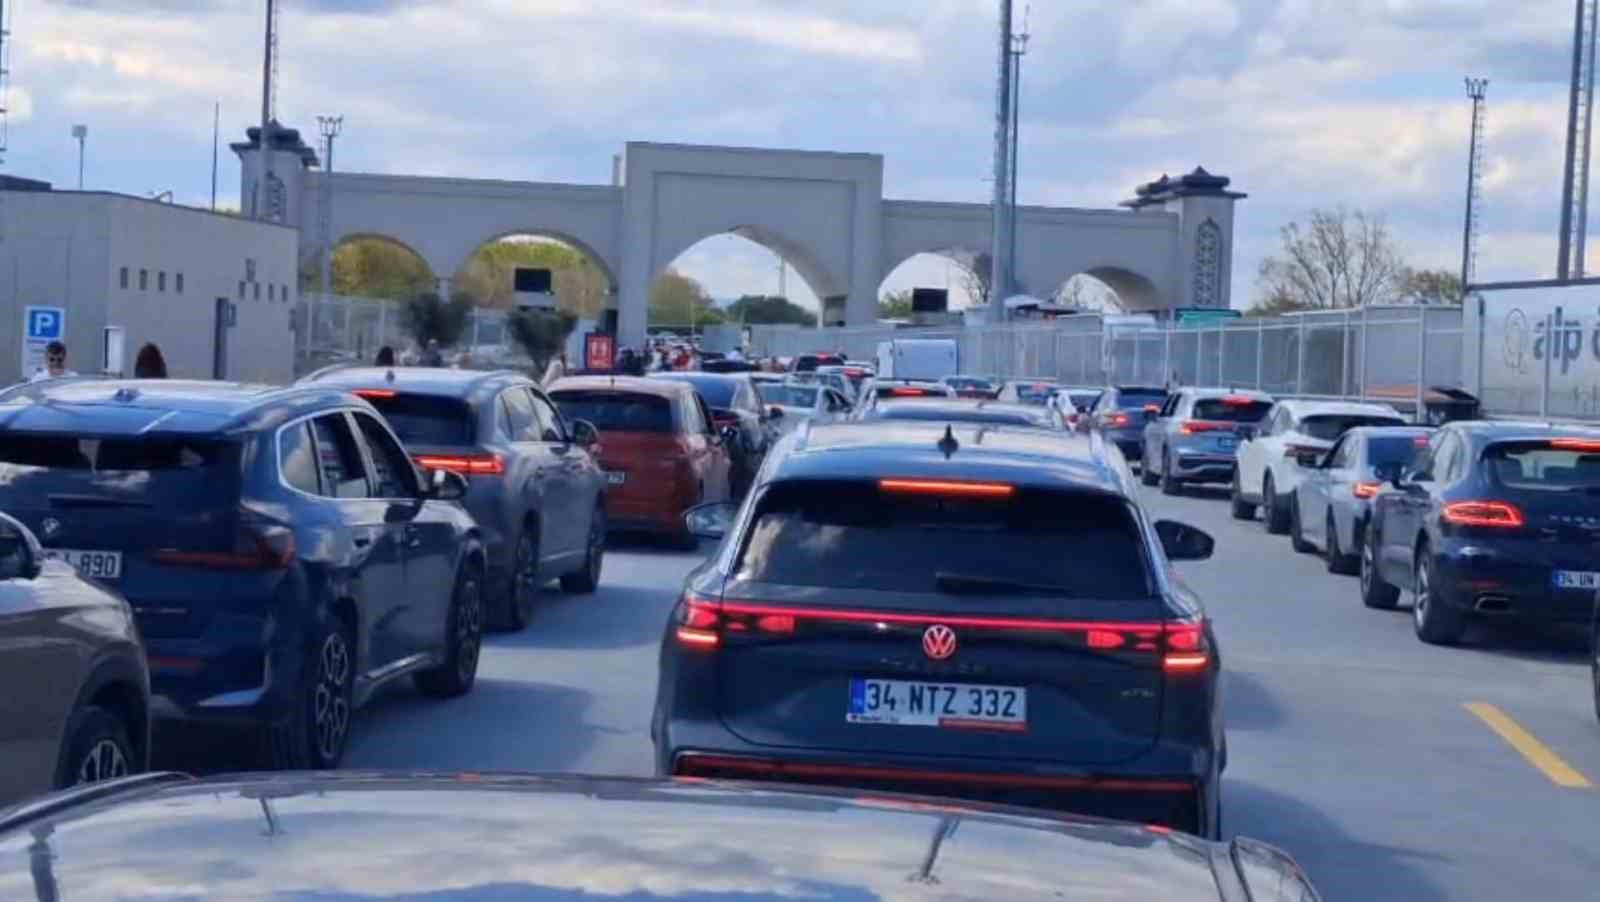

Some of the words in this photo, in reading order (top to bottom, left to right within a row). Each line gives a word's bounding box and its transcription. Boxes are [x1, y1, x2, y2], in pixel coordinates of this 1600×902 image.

[35, 313, 54, 335] P
[1533, 307, 1583, 374] alp
[80, 553, 116, 576] 890
[867, 683, 896, 711] 34
[909, 684, 958, 715] NTZ
[967, 688, 1017, 717] 332
